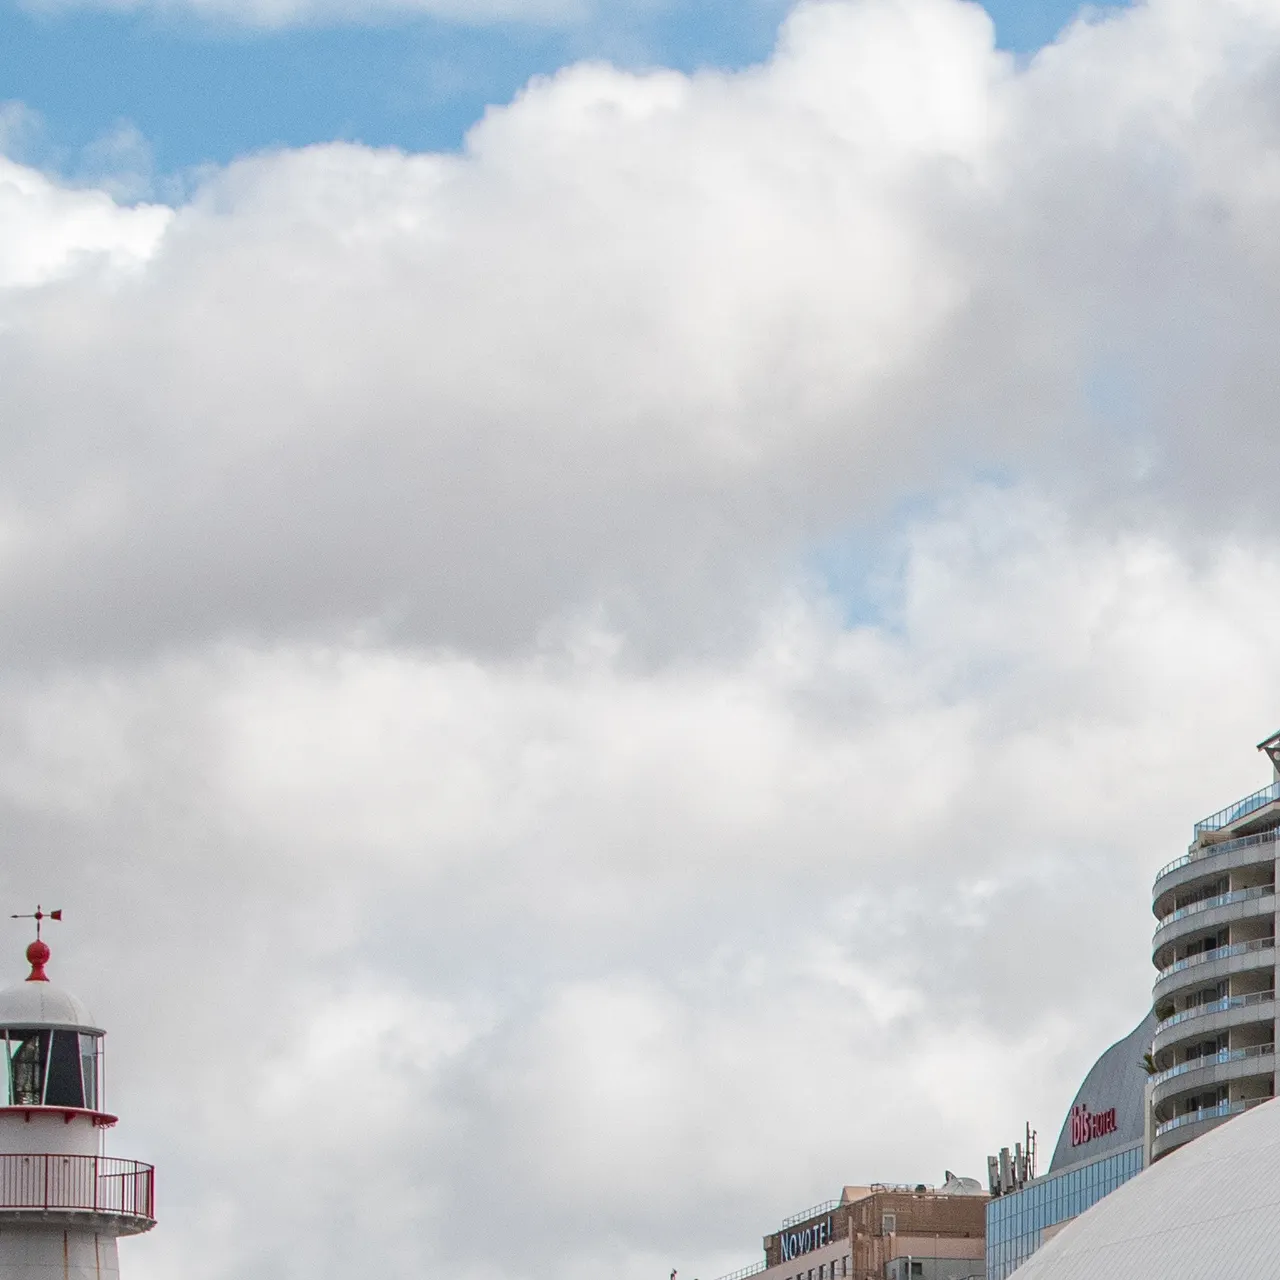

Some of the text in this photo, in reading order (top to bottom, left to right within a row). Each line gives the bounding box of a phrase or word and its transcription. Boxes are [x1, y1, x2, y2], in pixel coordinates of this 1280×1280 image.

[1071, 1103, 1117, 1147] ibis HOTEL
[780, 1215, 834, 1263] NOVOTEL
